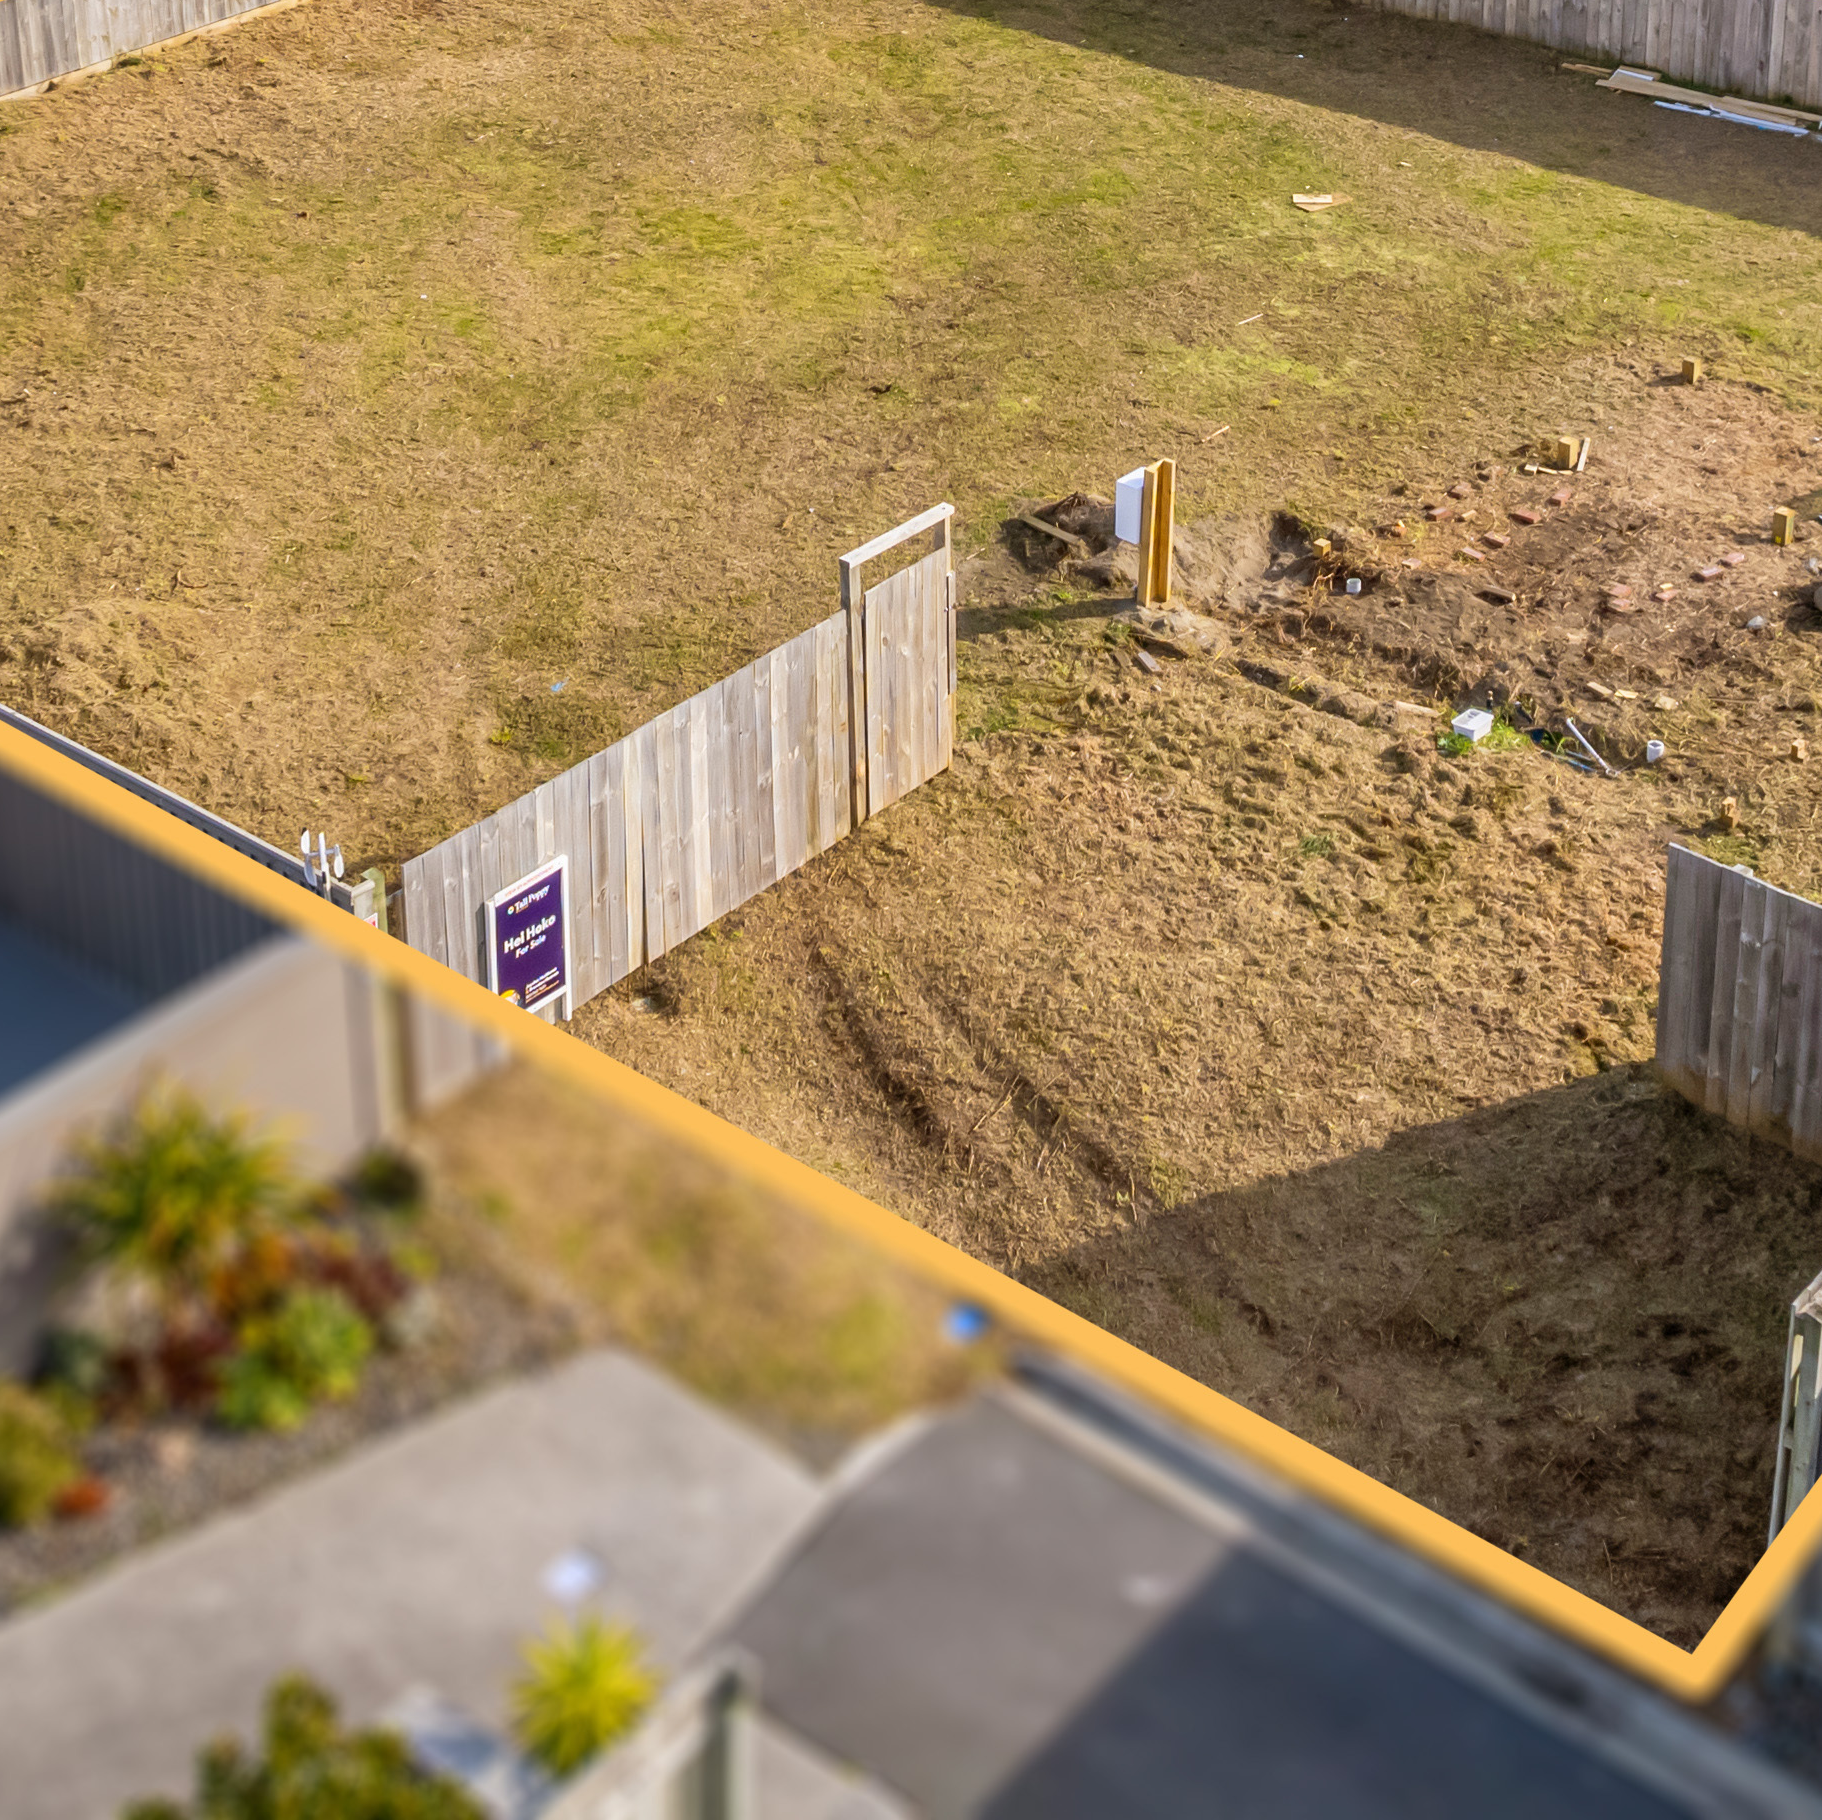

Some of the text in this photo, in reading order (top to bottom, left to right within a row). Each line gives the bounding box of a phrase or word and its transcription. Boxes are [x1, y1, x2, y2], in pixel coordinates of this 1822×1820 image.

[514, 896, 528, 911] Tall
[528, 884, 550, 903] Poppy
[526, 914, 556, 940] Hoko
[515, 935, 546, 958] For Sale
